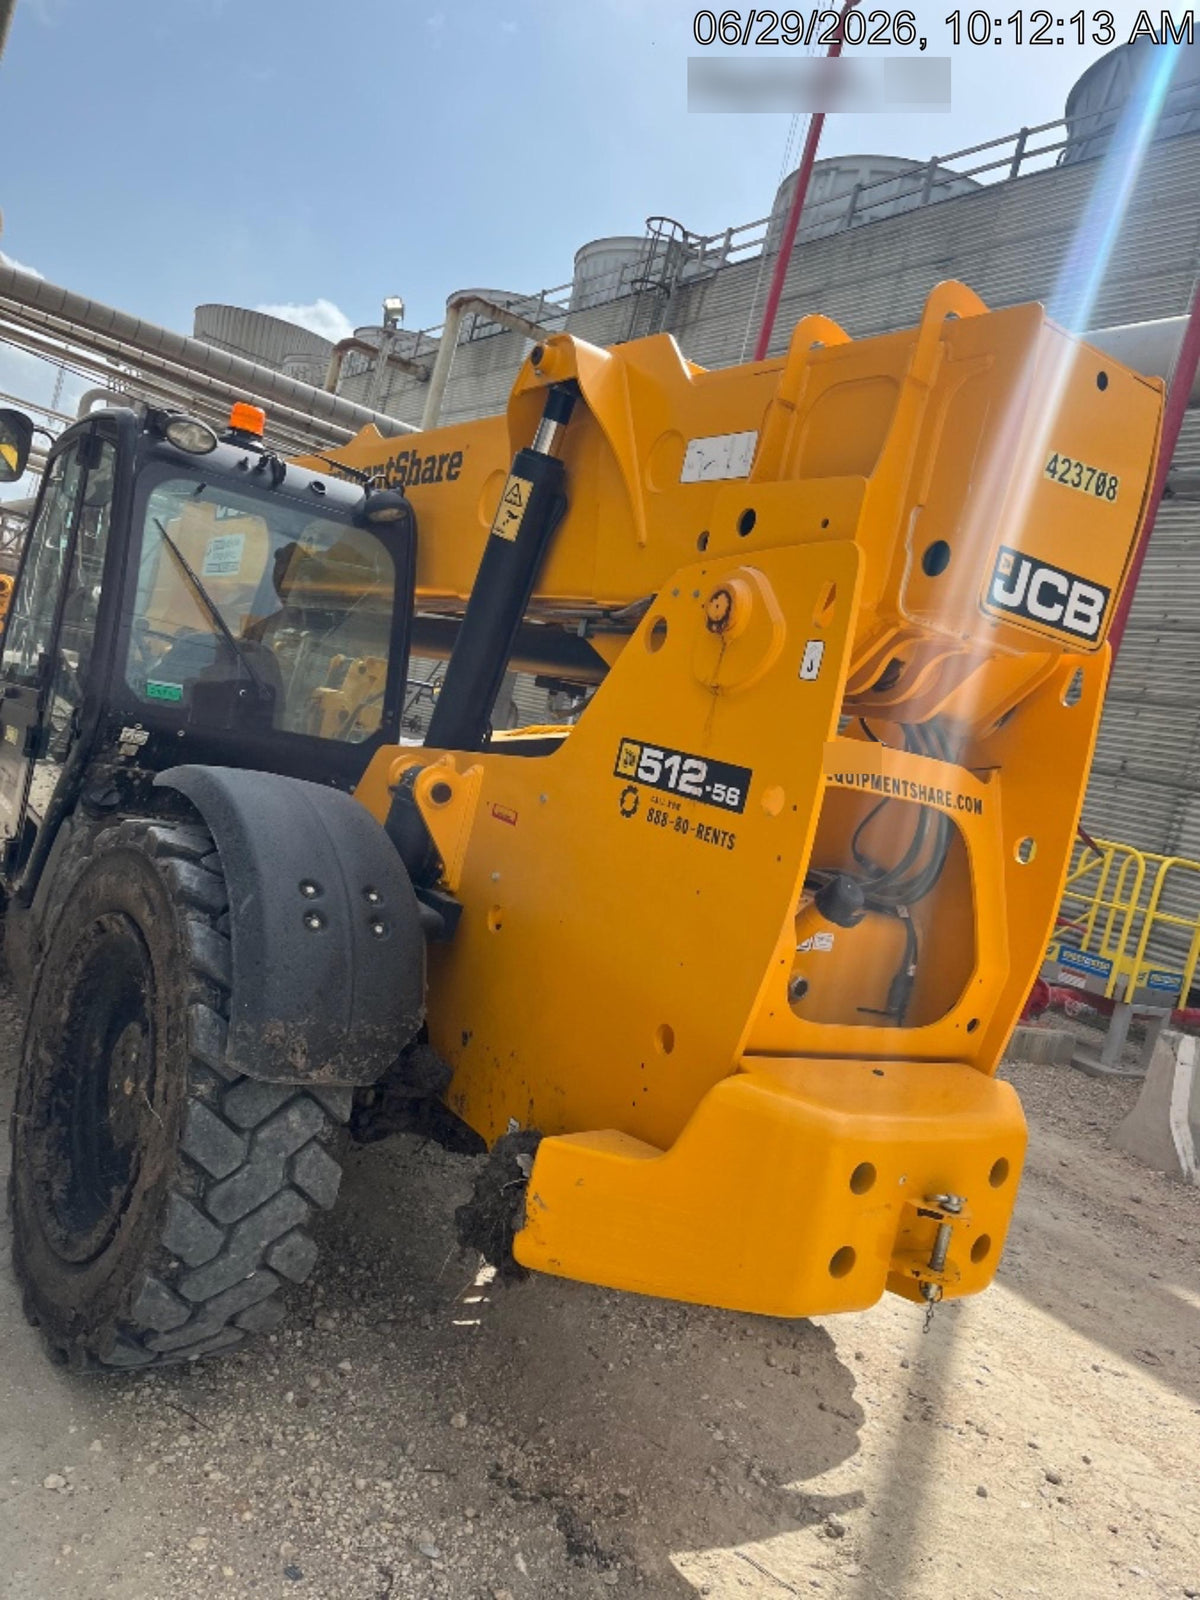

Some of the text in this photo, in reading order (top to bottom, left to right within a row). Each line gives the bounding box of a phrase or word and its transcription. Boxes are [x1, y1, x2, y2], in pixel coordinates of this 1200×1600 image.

[1045, 453, 1118, 501] 423708
[993, 559, 1105, 636] JCB
[646, 807, 736, 850] 888-80-RENTS
